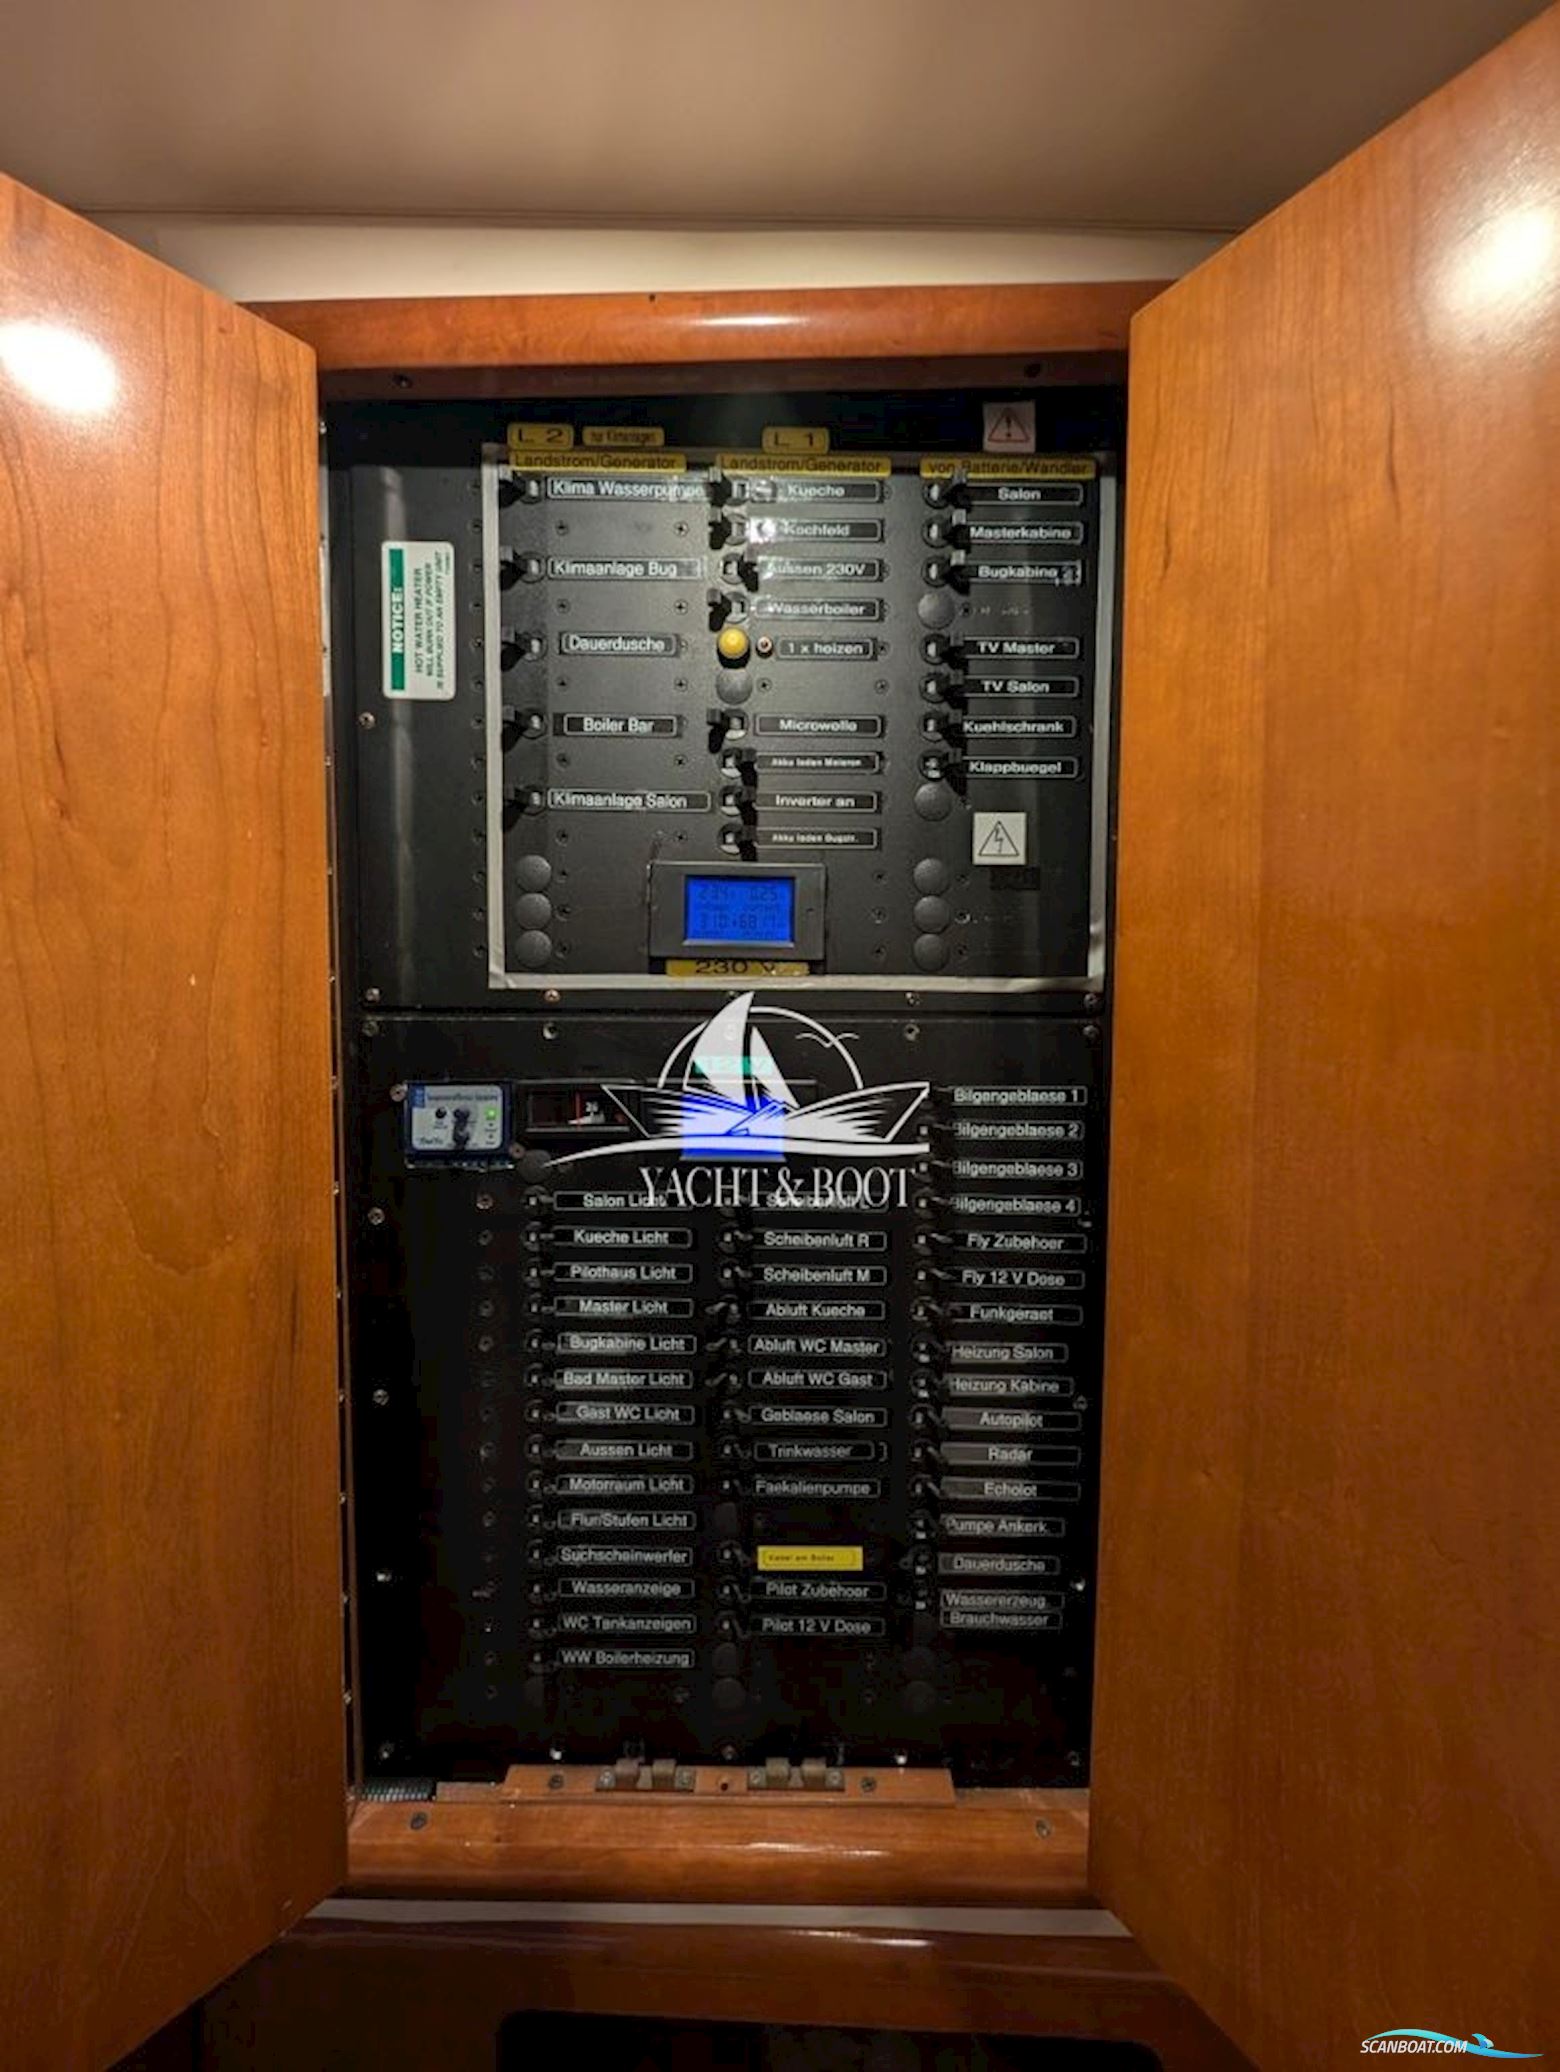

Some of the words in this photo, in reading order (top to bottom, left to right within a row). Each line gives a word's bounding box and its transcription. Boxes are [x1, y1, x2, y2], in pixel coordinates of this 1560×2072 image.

[518, 425, 533, 442] L
[546, 425, 563, 442] 2
[773, 432, 788, 447] L
[805, 433, 816, 447] 1
[515, 453, 676, 469] Landstrom/Generator
[721, 456, 882, 473] Landstrom/Generator
[929, 462, 955, 474] von
[553, 480, 594, 495] Klima
[599, 481, 705, 499] Wasserpumpe
[788, 485, 845, 497] Kueche
[997, 487, 1041, 500] Salon
[784, 523, 850, 536] Kochfeld
[970, 526, 1072, 539] Masterkabine
[555, 560, 644, 578] Klimaanlage
[649, 561, 677, 577] Bug
[826, 563, 866, 575] 230V
[414, 568, 424, 609] HEATER
[768, 601, 866, 615] Wasserboiler
[391, 587, 403, 653] NOTICE:
[414, 612, 424, 649] WATER
[569, 636, 665, 651] Dauerdusche
[787, 642, 795, 654] 1
[800, 645, 809, 654] x
[814, 642, 863, 655] heizen
[977, 642, 1000, 654] TV
[1003, 642, 1055, 654] Master
[981, 680, 1003, 692] TV
[1006, 681, 1049, 693] Salon
[583, 717, 624, 732] Boiler
[628, 718, 653, 732] Bar
[780, 718, 857, 732] Microwelle
[963, 720, 1064, 733] Kuehlschrank
[969, 760, 1062, 775] Klappbuegel
[554, 791, 642, 808] Klimaanlage
[646, 793, 688, 809] Salon
[776, 794, 833, 807] Inverter
[835, 797, 855, 807] an
[695, 959, 748, 974] 230
[954, 1088, 1066, 1104] Bilgengeblaese
[1072, 1090, 1078, 1102] 1
[1068, 1124, 1079, 1137] 2
[1067, 1163, 1078, 1176] 3
[583, 1193, 625, 1208] Salon
[1065, 1199, 1076, 1213] 4
[574, 1230, 630, 1244] Kueche
[632, 1230, 669, 1244] Licht
[764, 1232, 854, 1248] Scheibenluft
[857, 1234, 870, 1248] R
[967, 1234, 990, 1249] Fly
[994, 1235, 1065, 1250] Zubehoer
[570, 1266, 637, 1280] Pilothaus
[641, 1266, 676, 1280] Licht
[763, 1268, 854, 1283] Scheibenluft
[856, 1270, 870, 1283] M
[962, 1270, 985, 1286] Fly
[990, 1272, 1008, 1285] 12
[1012, 1272, 1024, 1285] V
[1027, 1273, 1066, 1287] Dose
[579, 1300, 630, 1314] Master
[632, 1300, 669, 1314] Licht
[766, 1303, 808, 1317] Abluft
[811, 1303, 866, 1317] Kueche
[970, 1305, 1054, 1322] Funkgeraet
[569, 1336, 645, 1352] Bugkabine
[651, 1337, 685, 1351] Licht
[754, 1338, 796, 1352] Abluft
[799, 1339, 827, 1352] WC
[830, 1341, 880, 1355] Master
[1013, 1346, 1054, 1360] Salon
[563, 1372, 592, 1385] Bad
[595, 1372, 645, 1386] Master
[650, 1372, 684, 1386] Licht
[763, 1372, 804, 1385] Abluft
[808, 1373, 835, 1386] WC
[838, 1374, 873, 1388] Gast
[1011, 1379, 1060, 1393] Kabine
[576, 1406, 611, 1420] Gast
[614, 1407, 642, 1420] WC
[645, 1408, 680, 1421] Licht
[761, 1409, 829, 1423] Geblaese
[833, 1410, 875, 1424] Salon
[979, 1412, 1043, 1429] Autopilot
[579, 1443, 634, 1457] Aussen
[637, 1443, 673, 1457] Licht
[768, 1443, 854, 1458] Trinkwasser
[988, 1447, 1033, 1462] Radar
[569, 1478, 645, 1492] Motorraum
[650, 1478, 684, 1492] Licht
[755, 1480, 871, 1497] Faekalienpumpe
[984, 1482, 1038, 1497] Echolot
[652, 1513, 688, 1528] Licht
[561, 1548, 688, 1563] Suchscheinwerfer
[953, 1557, 1046, 1572] Dauerdusche
[572, 1580, 682, 1597] Wasseranzeige
[766, 1583, 797, 1597] Pilot
[801, 1584, 870, 1598] Zubehoer
[563, 1616, 588, 1629] WC
[592, 1615, 692, 1632] Tankanzeigen
[950, 1610, 1049, 1626] Brauchwasser
[762, 1618, 794, 1632] Pilot
[799, 1619, 813, 1632] 12
[818, 1620, 831, 1632] V
[834, 1620, 872, 1634] Dose
[561, 1650, 592, 1663] WW
[595, 1650, 690, 1667] Boilerheizung
